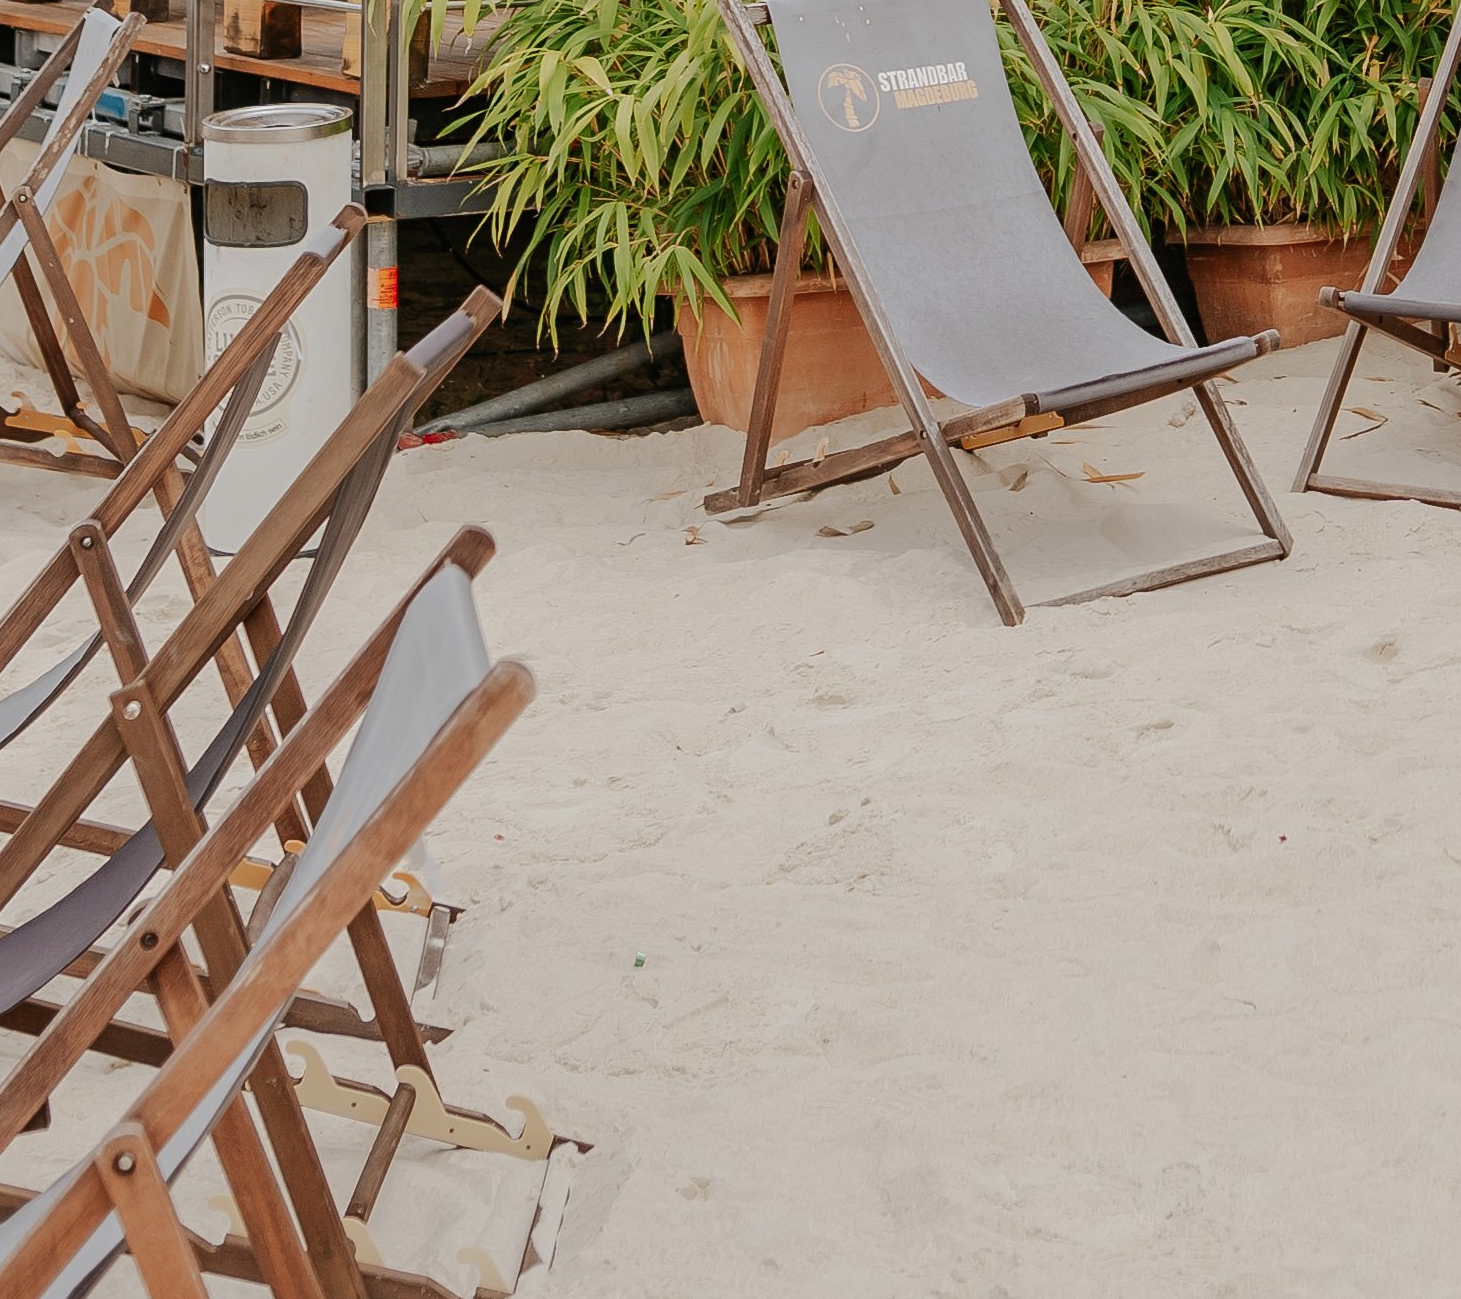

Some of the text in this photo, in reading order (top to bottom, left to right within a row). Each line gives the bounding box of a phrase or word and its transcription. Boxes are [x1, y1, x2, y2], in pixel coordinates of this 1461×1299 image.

[878, 61, 969, 92] STRANDBAR
[893, 79, 979, 109] MAGDEBURG
[279, 332, 293, 379] OMPANY
